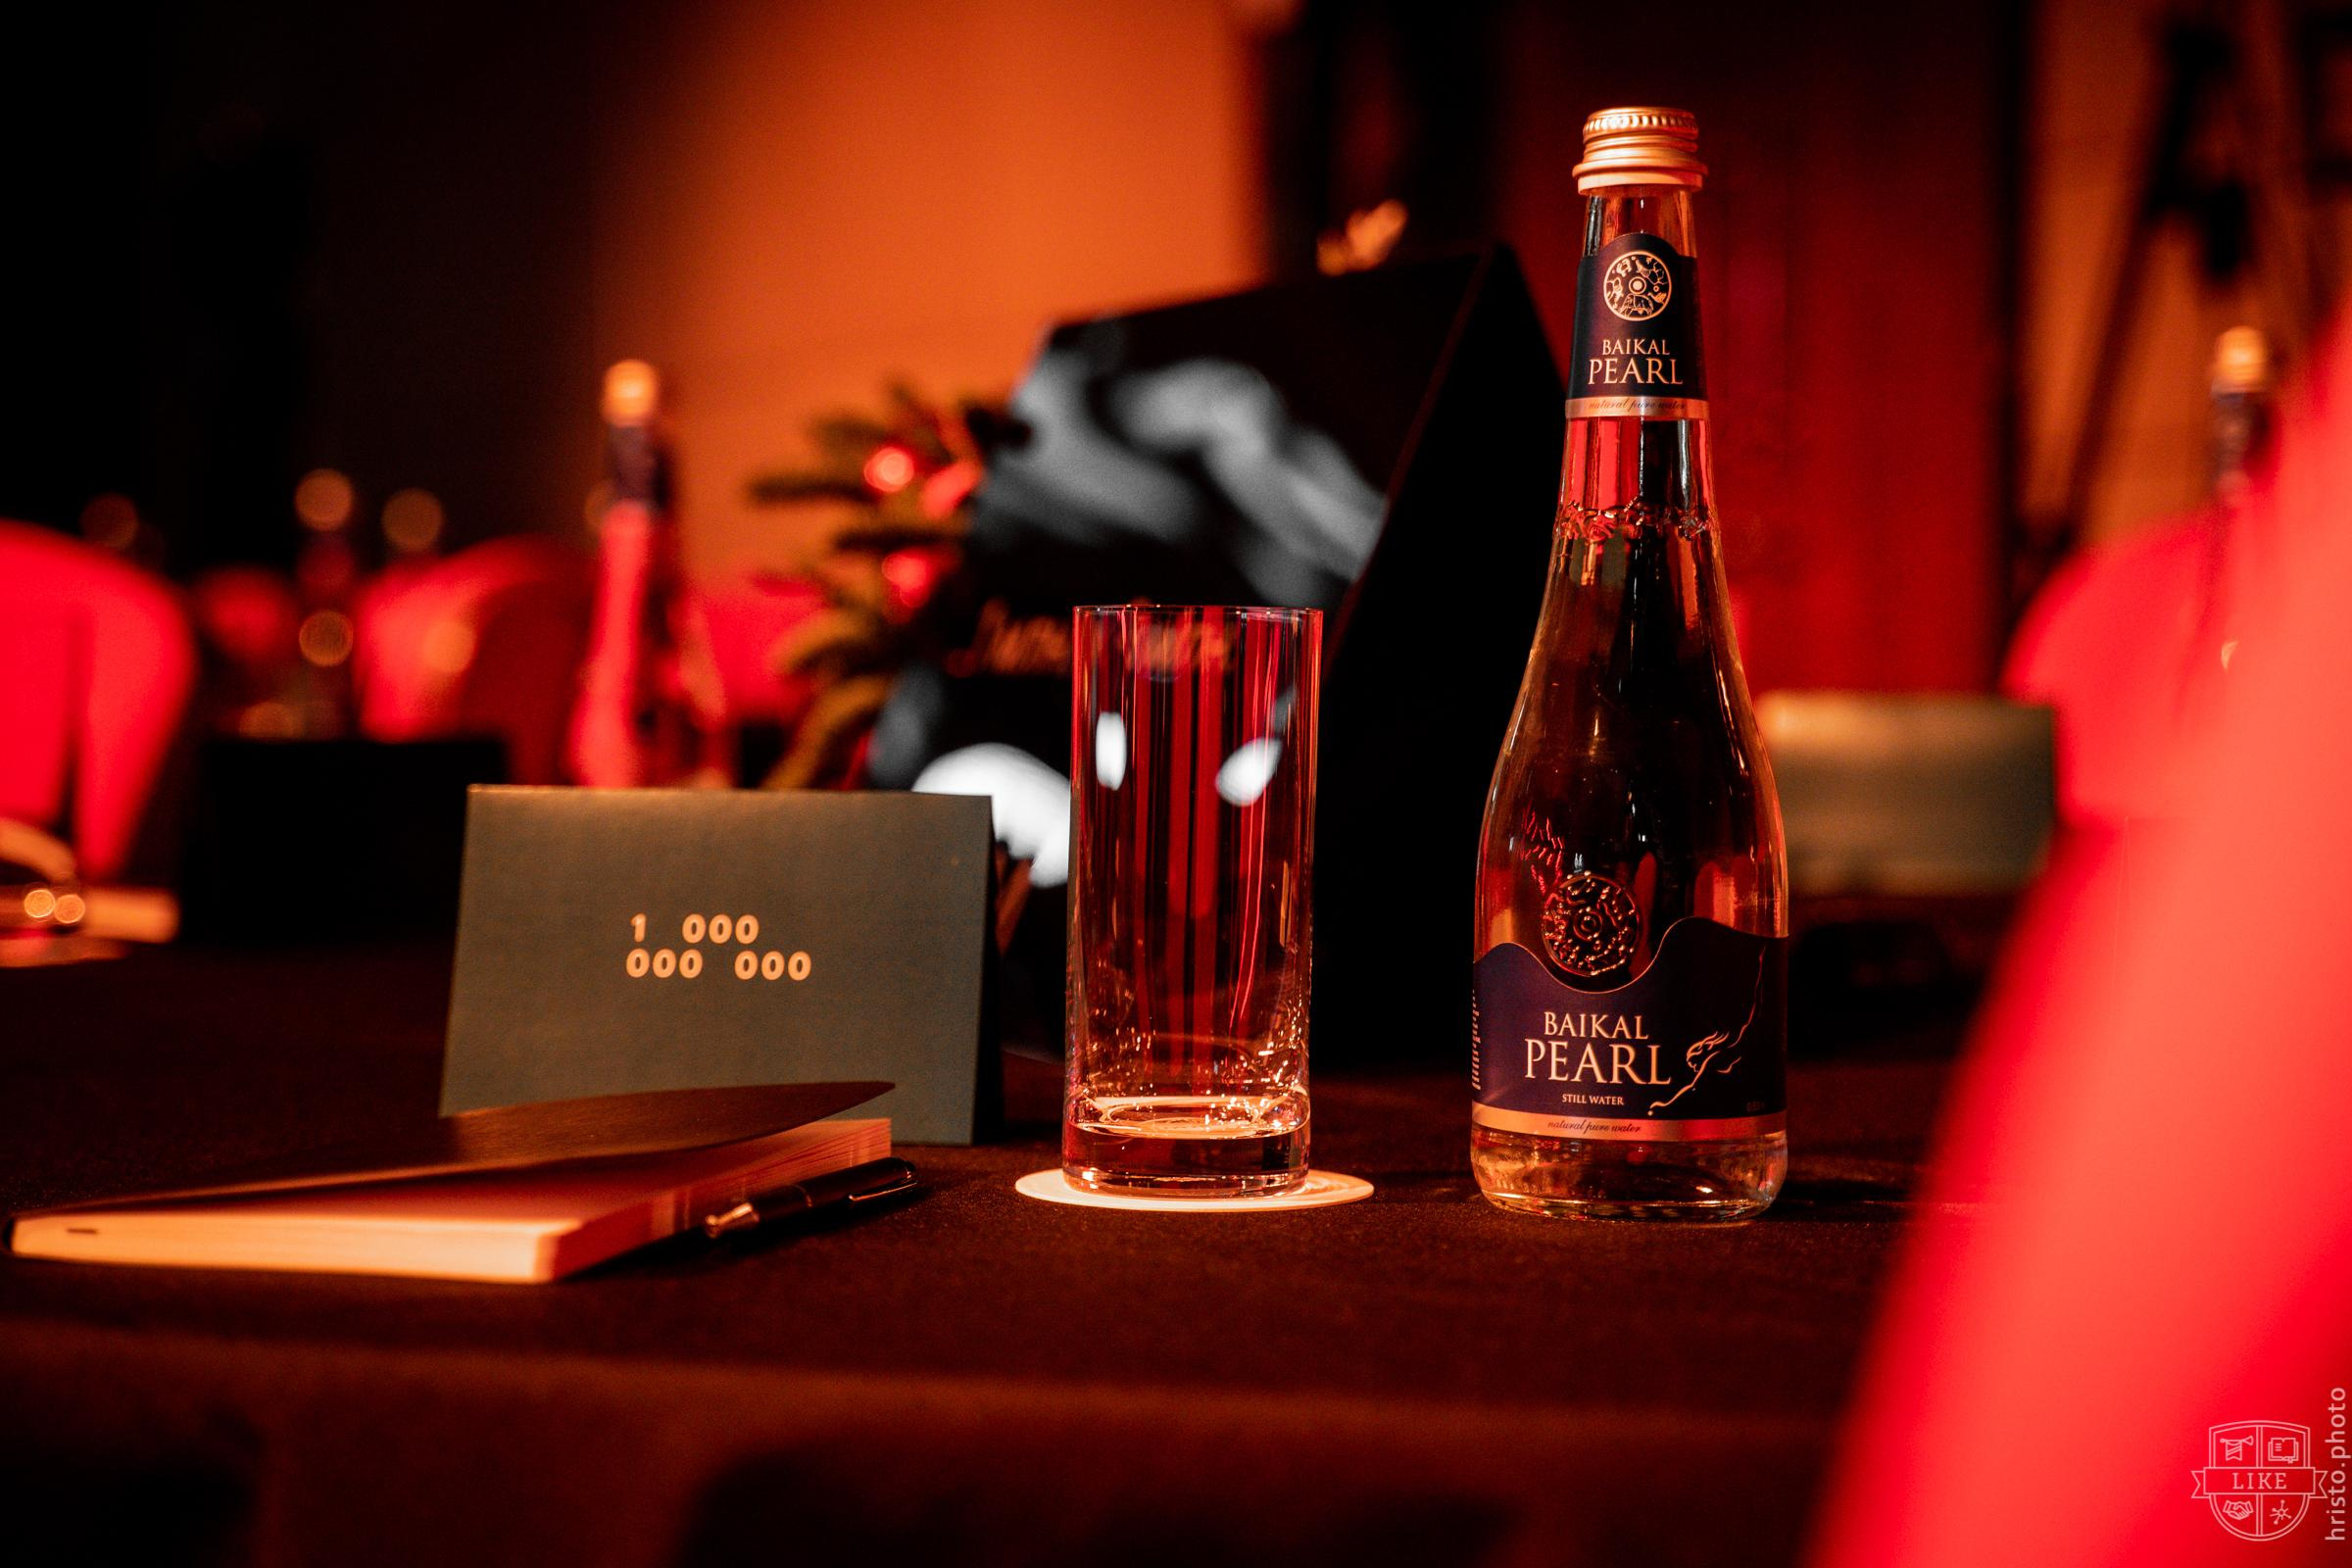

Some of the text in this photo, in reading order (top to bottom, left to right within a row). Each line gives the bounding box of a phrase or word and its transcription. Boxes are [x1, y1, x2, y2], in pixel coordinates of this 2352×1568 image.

[1602, 339, 1670, 356] BAIKAL
[1588, 358, 1684, 385] PEARL
[630, 912, 760, 945] 1 000
[625, 948, 811, 981] 000 000
[1544, 1011, 1648, 1040] BAIKAL
[1524, 1038, 1671, 1085] PEARL
[1561, 1094, 1625, 1105] STILL WATER
[1547, 1119, 1642, 1134] natural pure water
